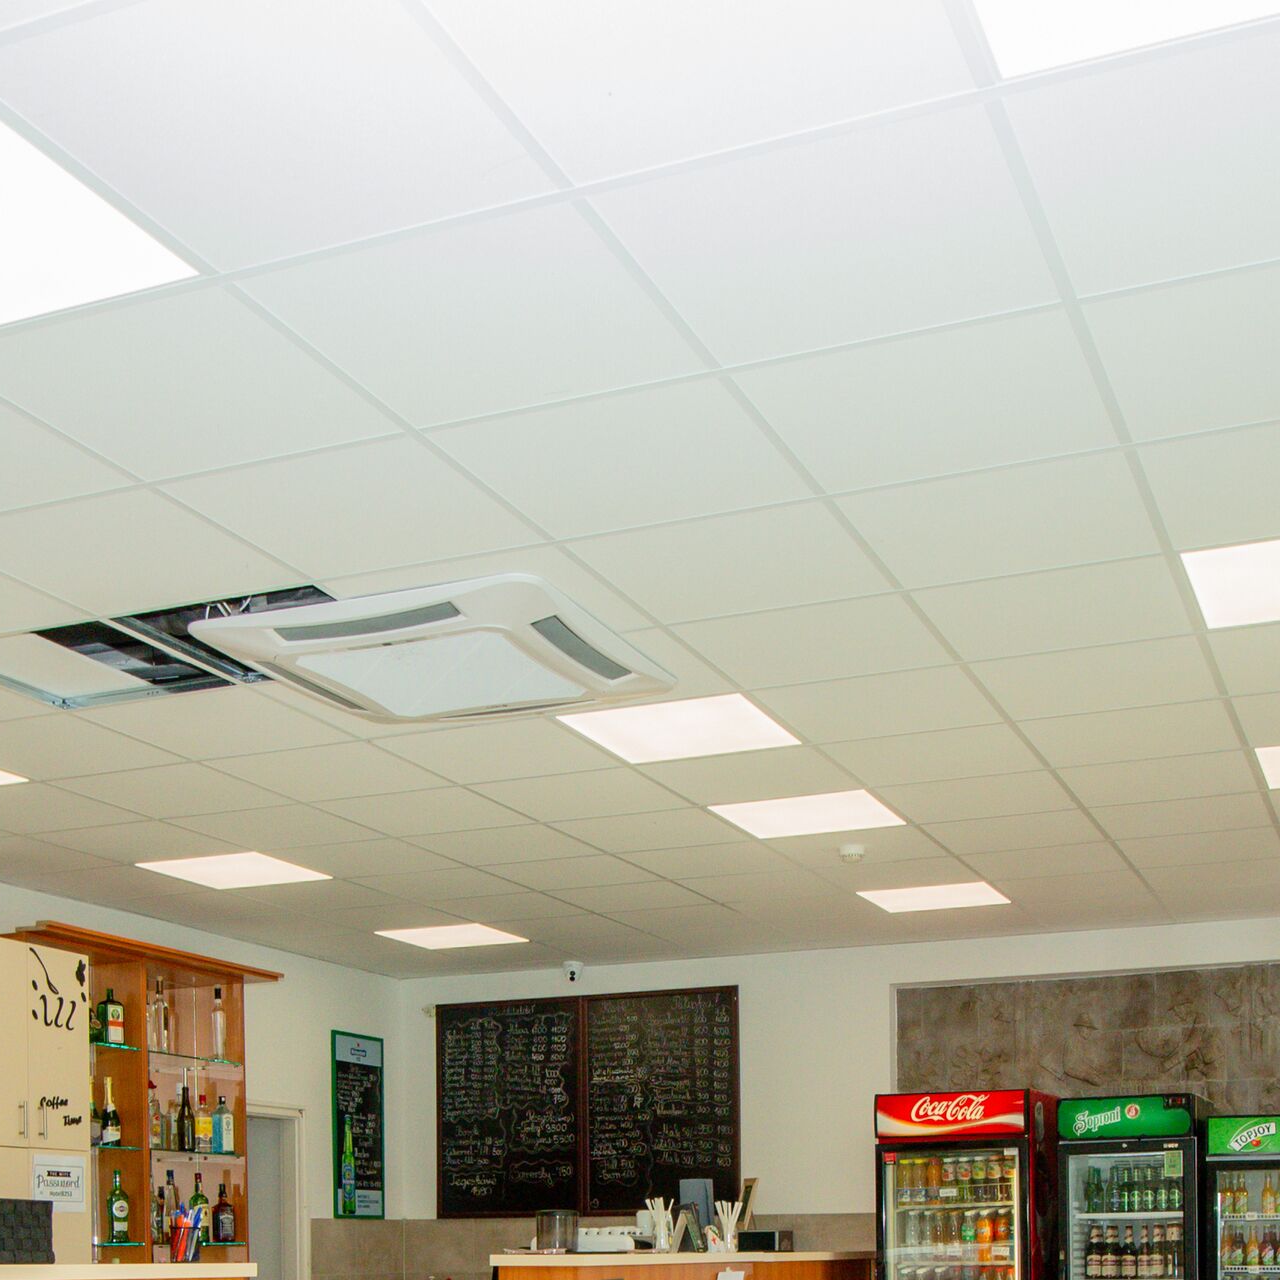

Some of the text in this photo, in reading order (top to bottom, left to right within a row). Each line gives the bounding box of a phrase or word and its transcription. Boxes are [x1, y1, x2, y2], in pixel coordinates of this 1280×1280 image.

[40, 1096, 69, 1110] Coffee
[910, 1094, 990, 1122] Coca-Cola
[63, 1115, 82, 1126] Time
[1073, 1105, 1121, 1136] Soproni
[1234, 1124, 1272, 1147] TOPJOY
